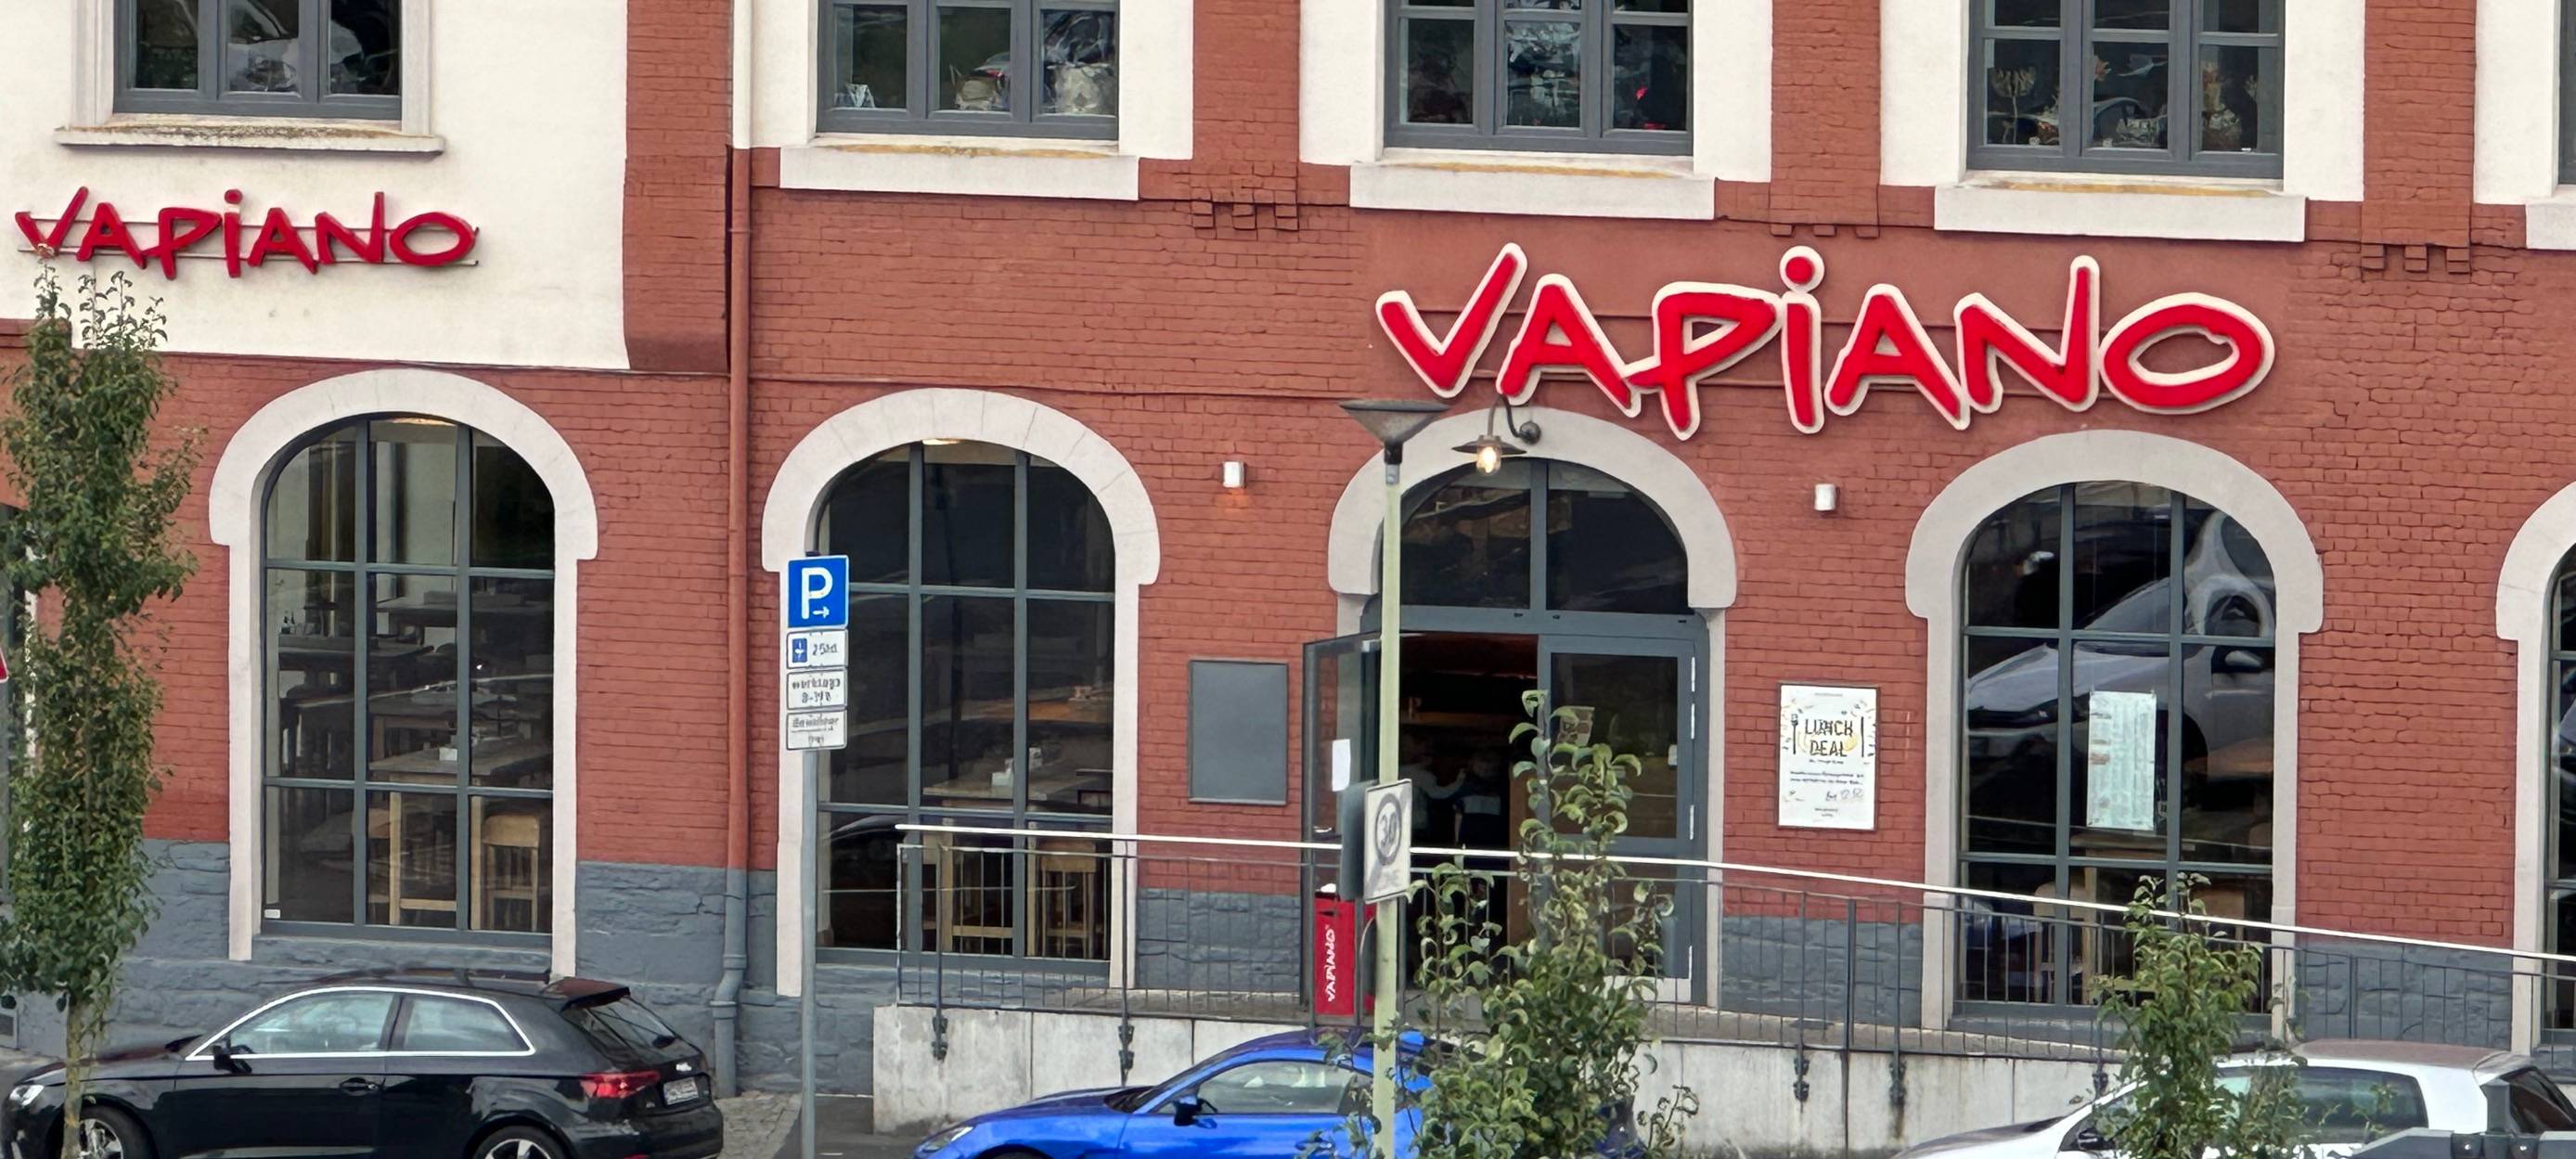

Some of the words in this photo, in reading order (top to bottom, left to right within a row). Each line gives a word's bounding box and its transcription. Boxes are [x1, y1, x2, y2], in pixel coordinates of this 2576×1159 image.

[802, 566, 833, 620] P
[1805, 718, 1854, 737] LUNCH
[1810, 740, 1848, 757] DEAL
[1380, 811, 1398, 849] 30
